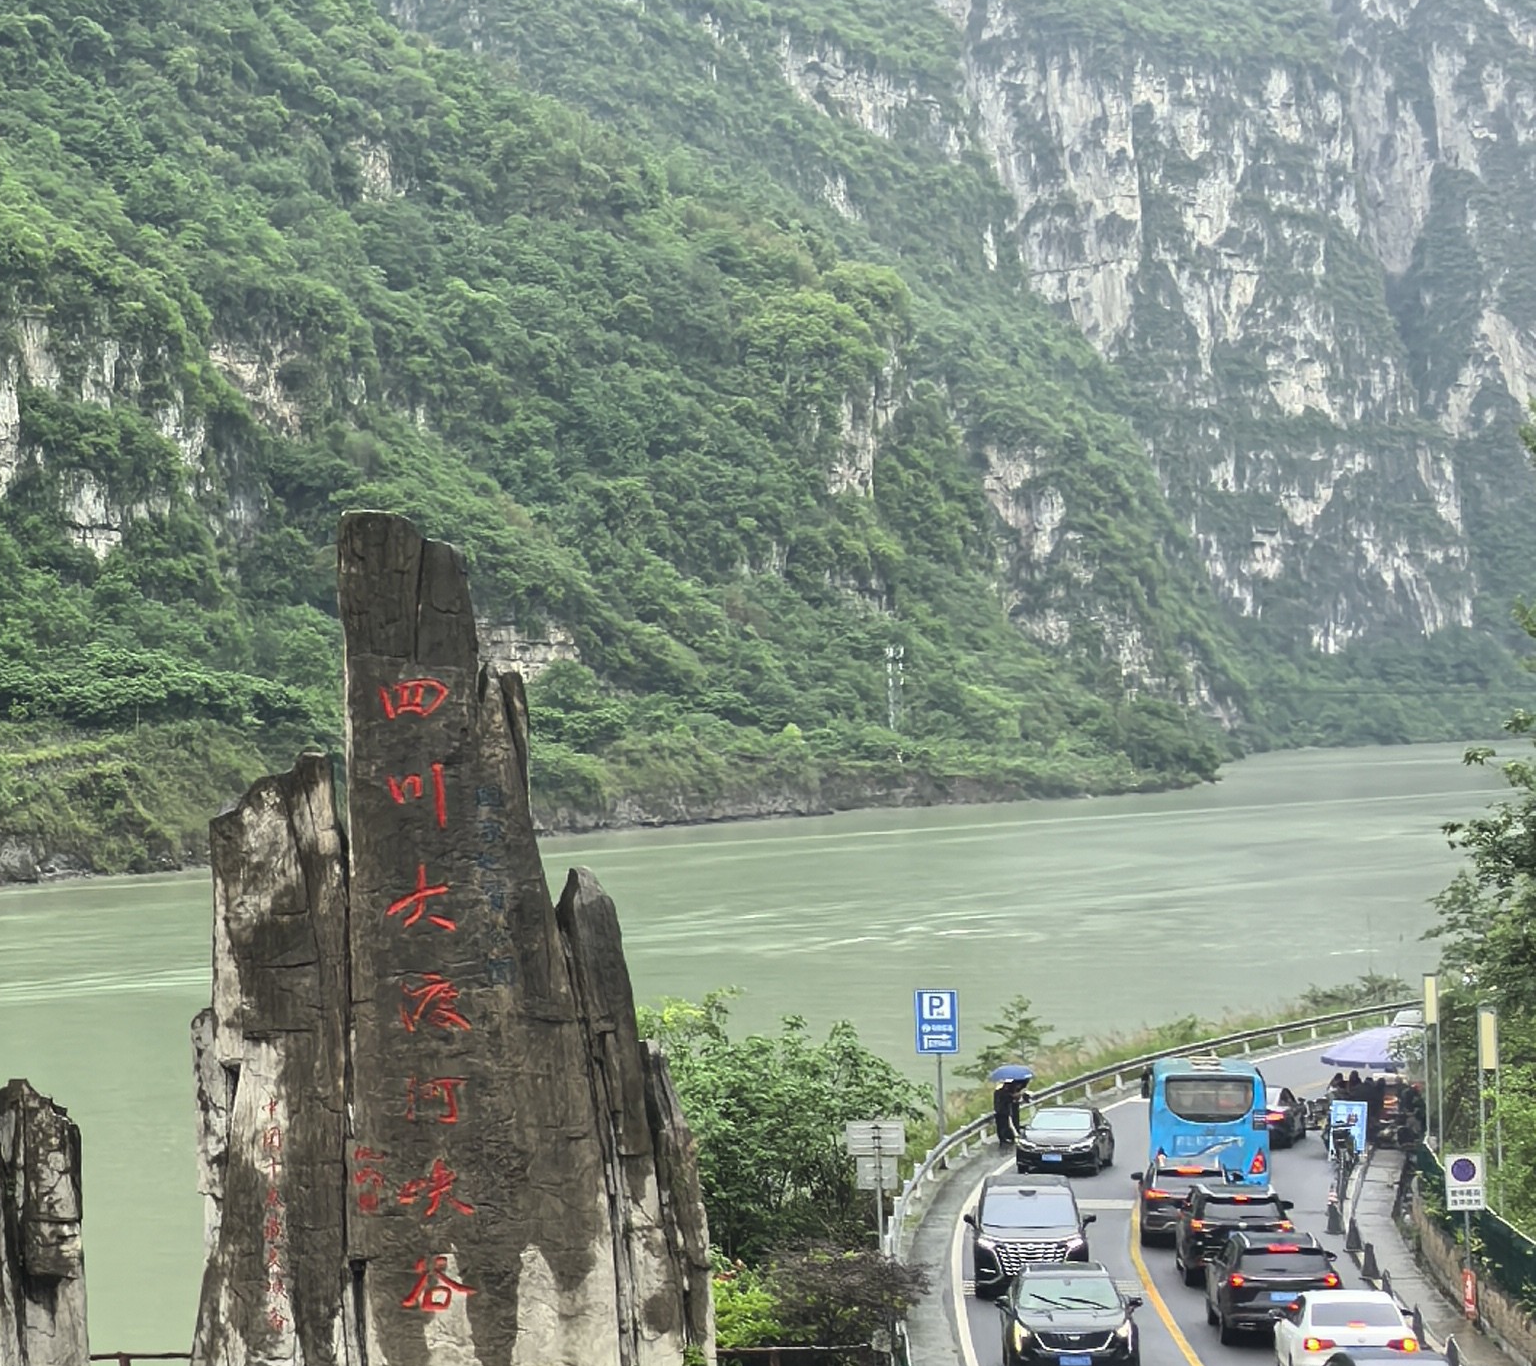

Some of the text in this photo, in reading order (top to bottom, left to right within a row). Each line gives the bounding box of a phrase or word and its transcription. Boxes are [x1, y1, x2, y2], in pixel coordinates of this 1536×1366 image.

[379, 677, 477, 1313] 四川大渡河峡谷
[929, 995, 944, 1016] P
